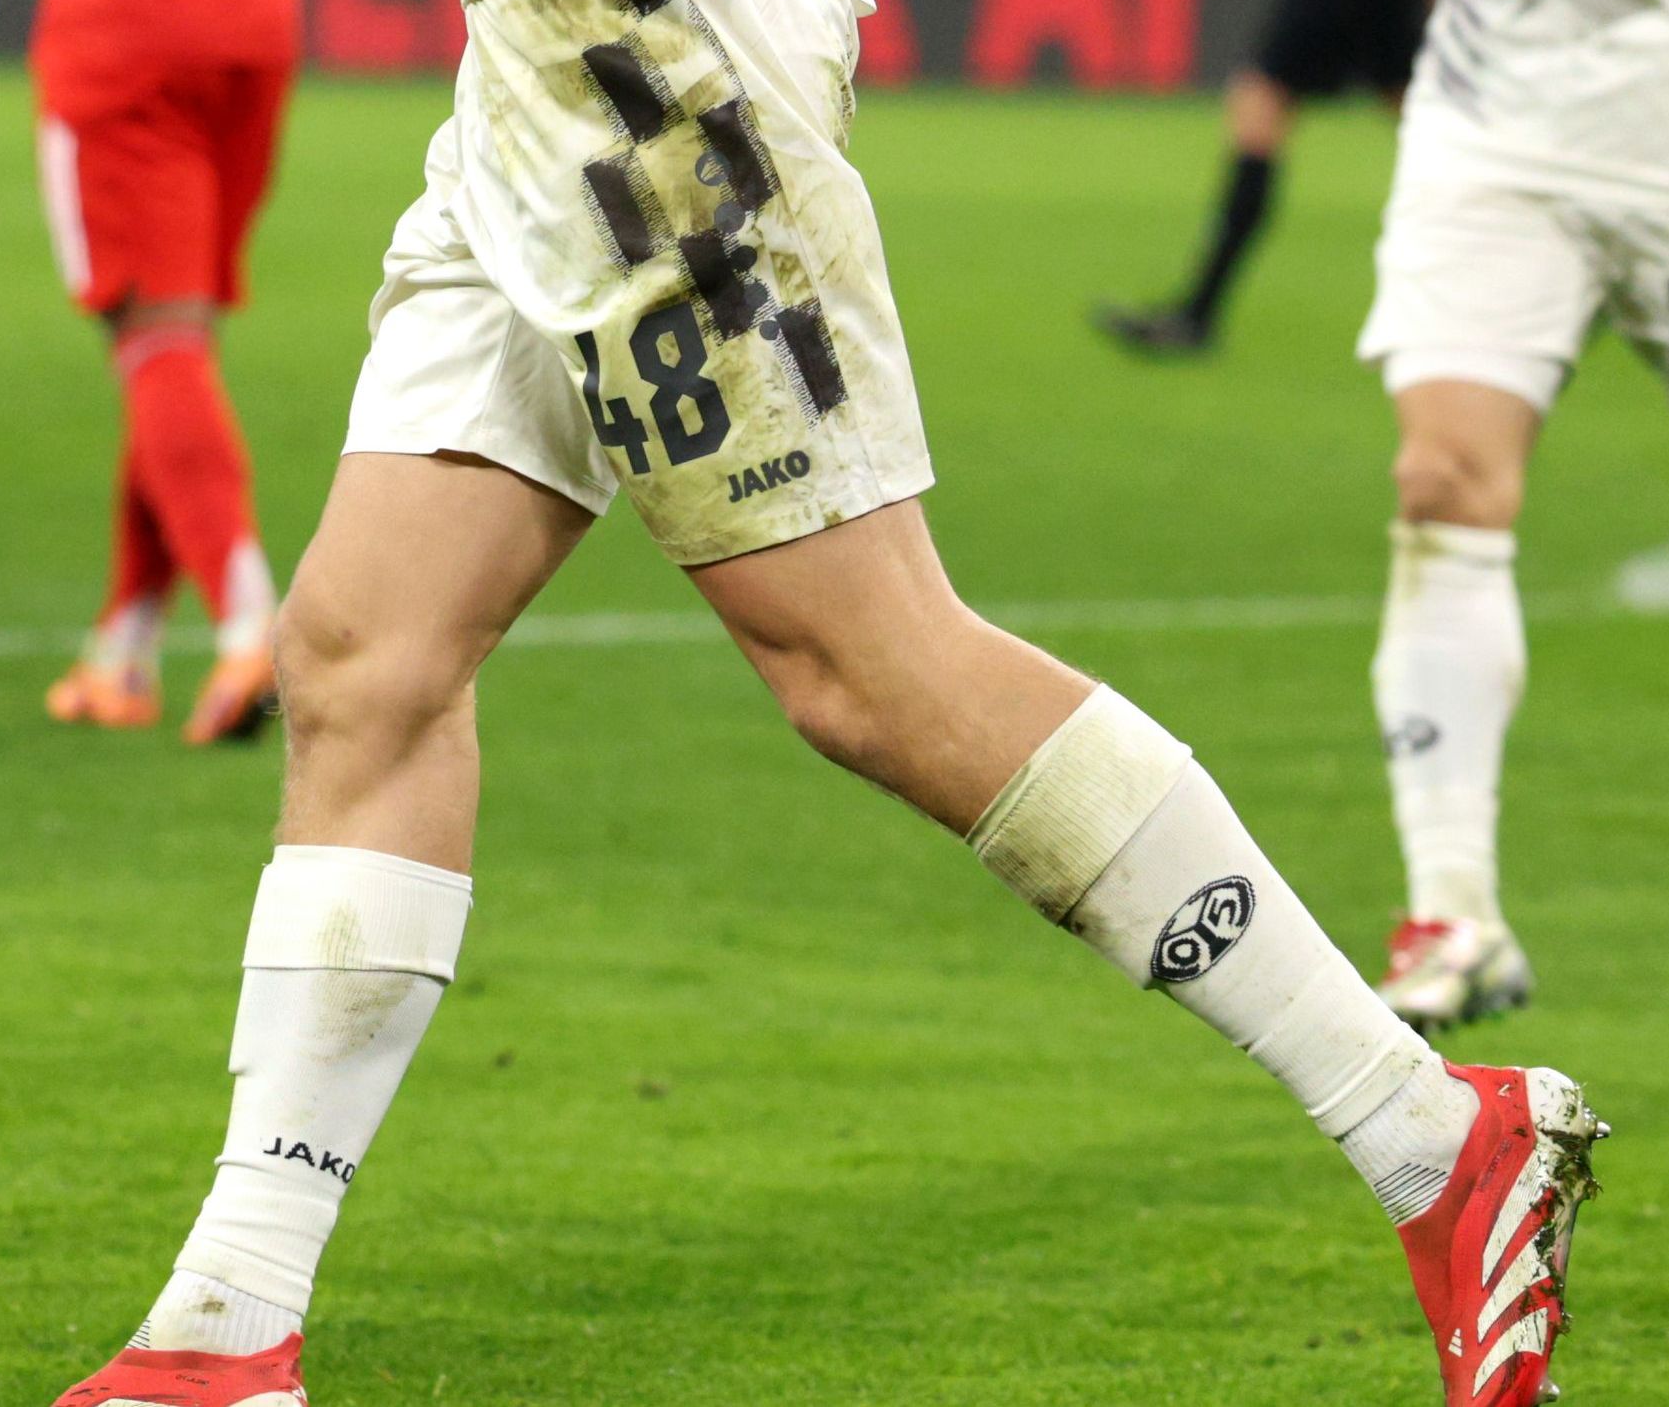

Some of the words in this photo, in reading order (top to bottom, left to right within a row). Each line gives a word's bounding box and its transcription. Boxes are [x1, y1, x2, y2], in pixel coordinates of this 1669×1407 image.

[574, 300, 732, 476] 48
[726, 449, 812, 504] JAKO
[262, 1137, 356, 1185] JAKO
